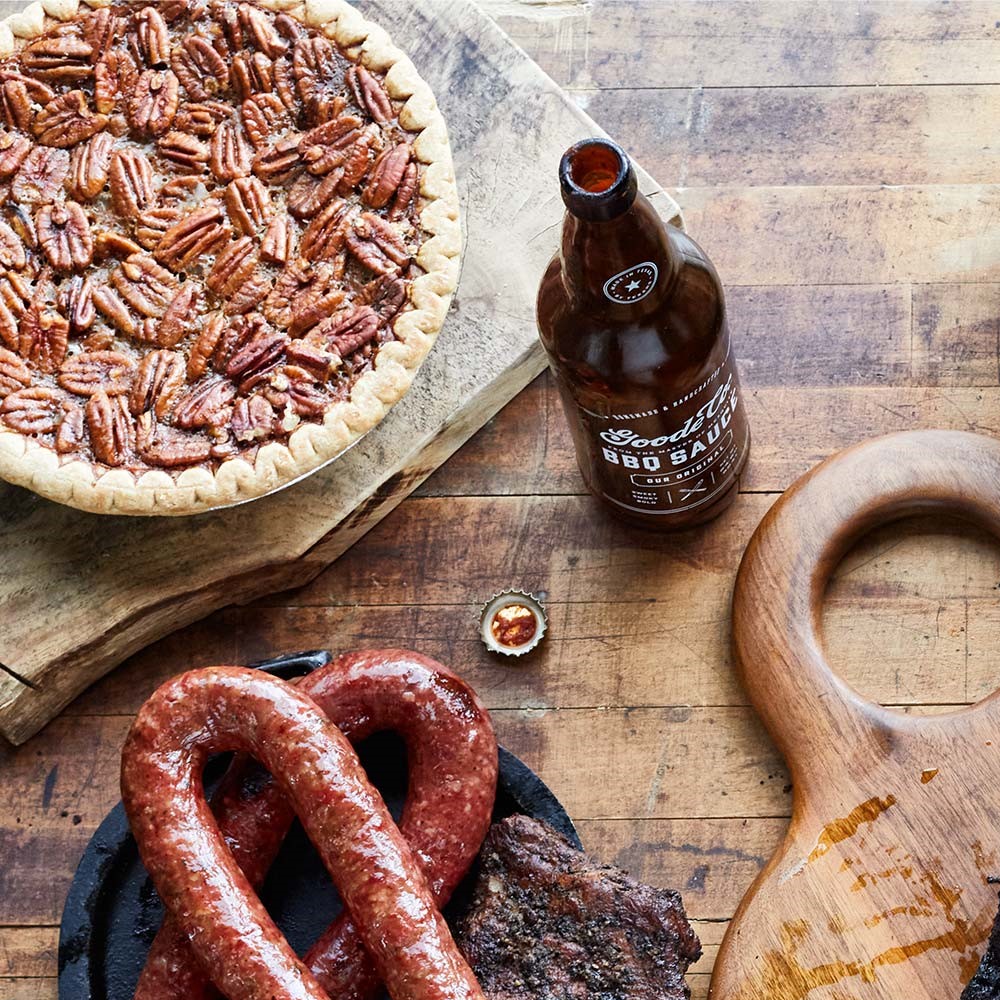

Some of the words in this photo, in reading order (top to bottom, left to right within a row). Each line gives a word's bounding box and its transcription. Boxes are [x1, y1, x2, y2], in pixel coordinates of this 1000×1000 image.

[600, 416, 705, 448] Goode
[602, 447, 660, 471] BBQ
[670, 387, 738, 466] SAUCE
[676, 446, 724, 479] ORIGINAL
